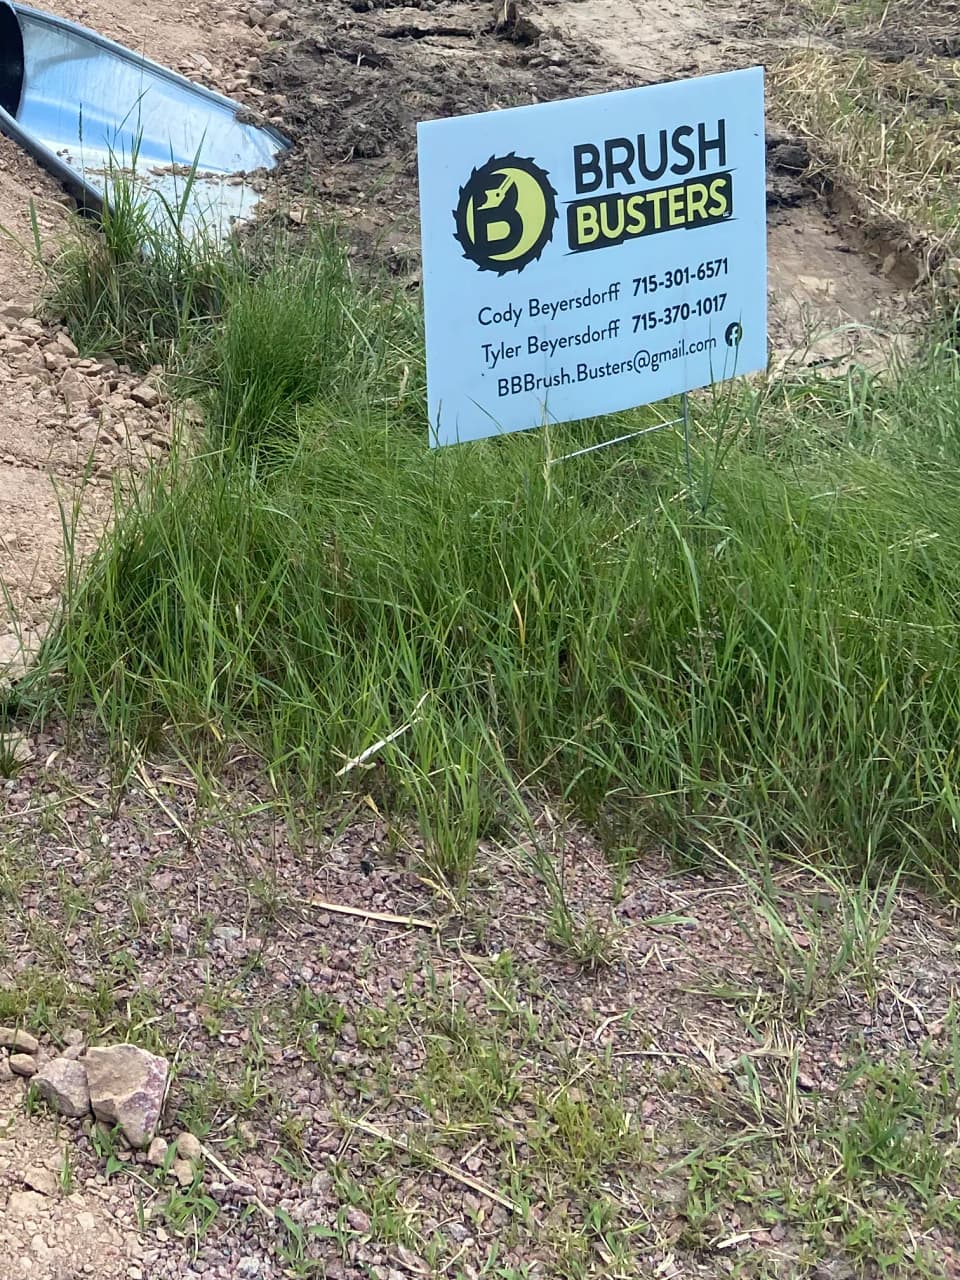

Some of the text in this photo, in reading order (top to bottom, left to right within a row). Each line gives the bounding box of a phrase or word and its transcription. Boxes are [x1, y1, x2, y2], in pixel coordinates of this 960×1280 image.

[573, 118, 727, 195] BRUSH
[576, 178, 728, 246] BUSTERS
[478, 257, 728, 327] Cody Beyersdorff 715-301-6571
[481, 293, 728, 369] Tyler Beyersdorff 715-370-1017
[498, 337, 717, 397] BBBrush.Busters@gmail.com
